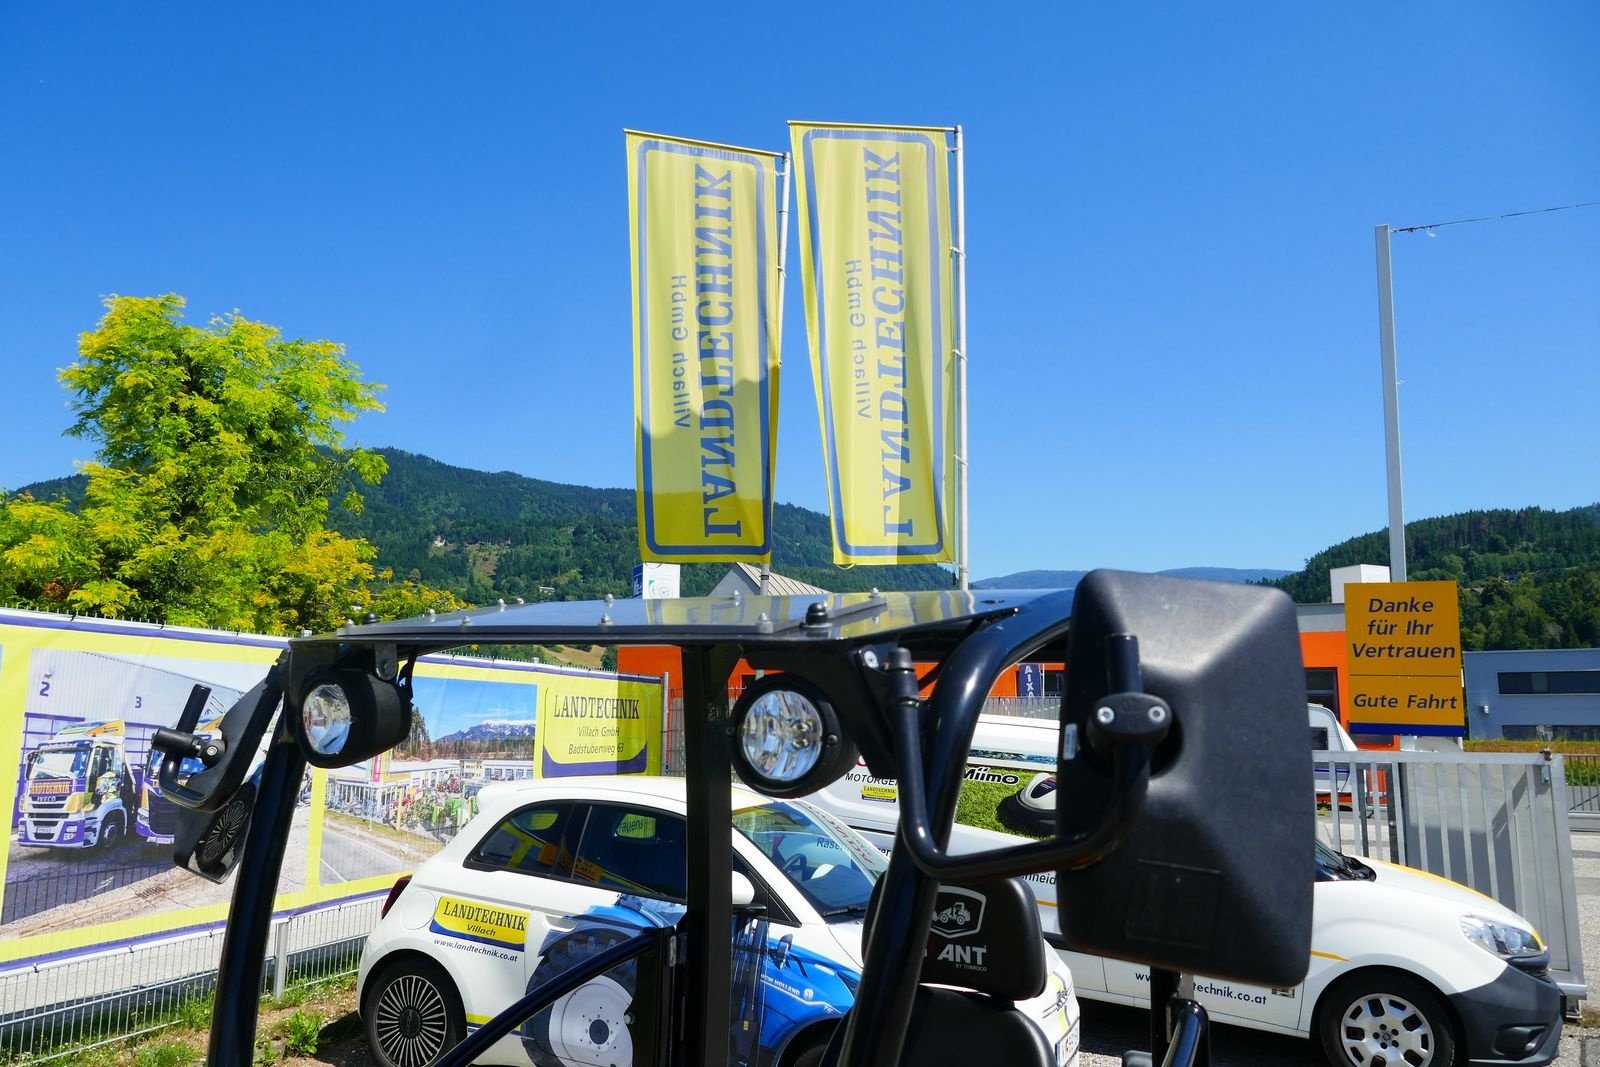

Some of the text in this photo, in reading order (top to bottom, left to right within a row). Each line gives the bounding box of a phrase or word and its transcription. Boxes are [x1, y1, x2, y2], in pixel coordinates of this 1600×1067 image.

[1368, 597, 1434, 613] Danke
[1367, 619, 1434, 635] für Ihr
[1352, 643, 1456, 658] Vertrauen
[39, 681, 50, 697] 2
[135, 696, 142, 709] 3
[554, 695, 640, 719] LANDTECHNIK
[1353, 694, 1457, 709] Gute Fahrt
[578, 726, 620, 737] Villach GmbH
[845, 773, 898, 786] MOTORGE
[443, 901, 527, 931] LANDTECHNIK
[467, 924, 496, 936] Villach
[433, 939, 518, 962] www.landtechnik.co.at
[925, 943, 987, 965] ANT
